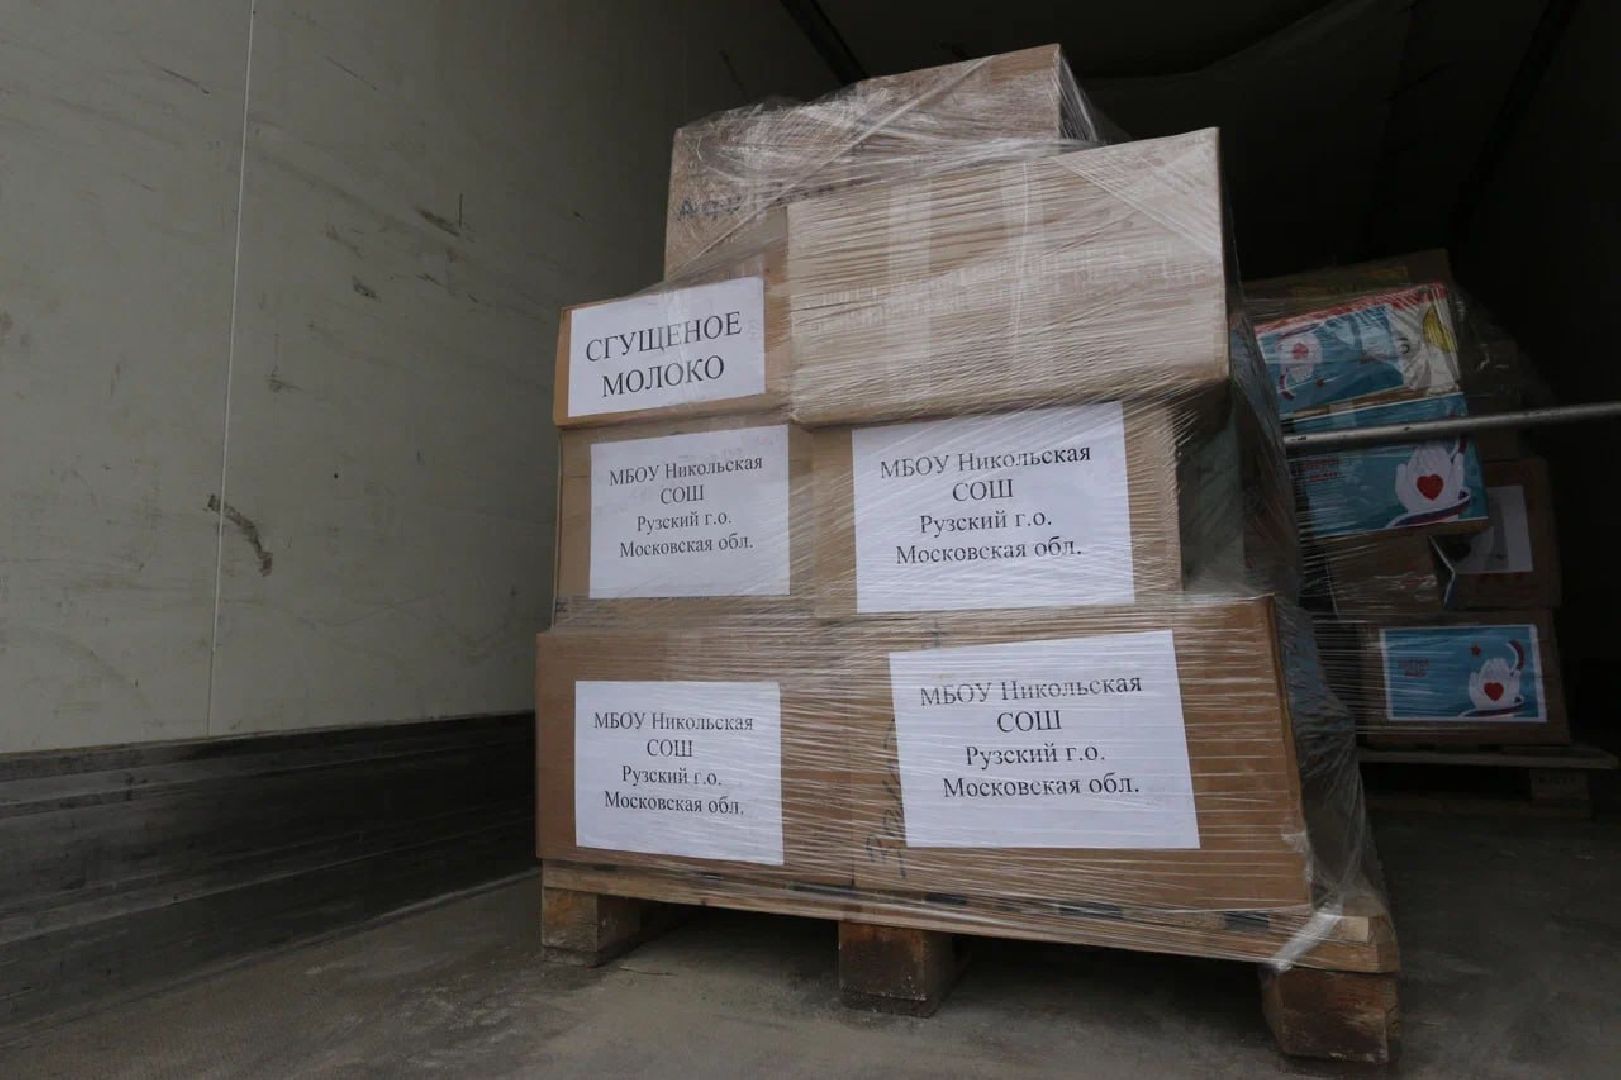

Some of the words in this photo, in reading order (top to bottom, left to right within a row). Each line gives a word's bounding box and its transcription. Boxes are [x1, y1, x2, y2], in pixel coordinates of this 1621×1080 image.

[586, 311, 742, 362] СГУЩЕНОЕ
[602, 355, 724, 397] МОЛОКО
[609, 465, 659, 486] МБОУ
[666, 456, 763, 479] Никольская
[880, 455, 950, 478] МБОУ
[958, 447, 1091, 472] Никольская
[661, 484, 705, 505] СОШ
[952, 478, 1014, 501] СОШ
[637, 511, 698, 535] Рузский
[705, 512, 732, 526] г.о.
[920, 510, 1007, 538] Рузский
[1015, 511, 1052, 527] г.о.
[620, 539, 712, 558] Московская
[719, 533, 753, 550] обл.
[896, 543, 1026, 564] Московская
[1034, 536, 1082, 556] обл.
[920, 682, 992, 706] МБОУ
[1001, 677, 1142, 701] Никольская
[594, 711, 645, 730] МБОУ
[652, 712, 753, 730] Никольская
[997, 710, 1062, 733] СОШ
[647, 739, 692, 757] СОШ
[966, 743, 1057, 770] Рузский
[1066, 746, 1105, 761] г.о.
[622, 765, 688, 786] Рузский
[694, 772, 722, 786] г.о.
[943, 777, 1080, 797] Московская
[1089, 772, 1139, 793] обл.
[605, 791, 701, 812] Московская
[708, 796, 744, 815] обл.
